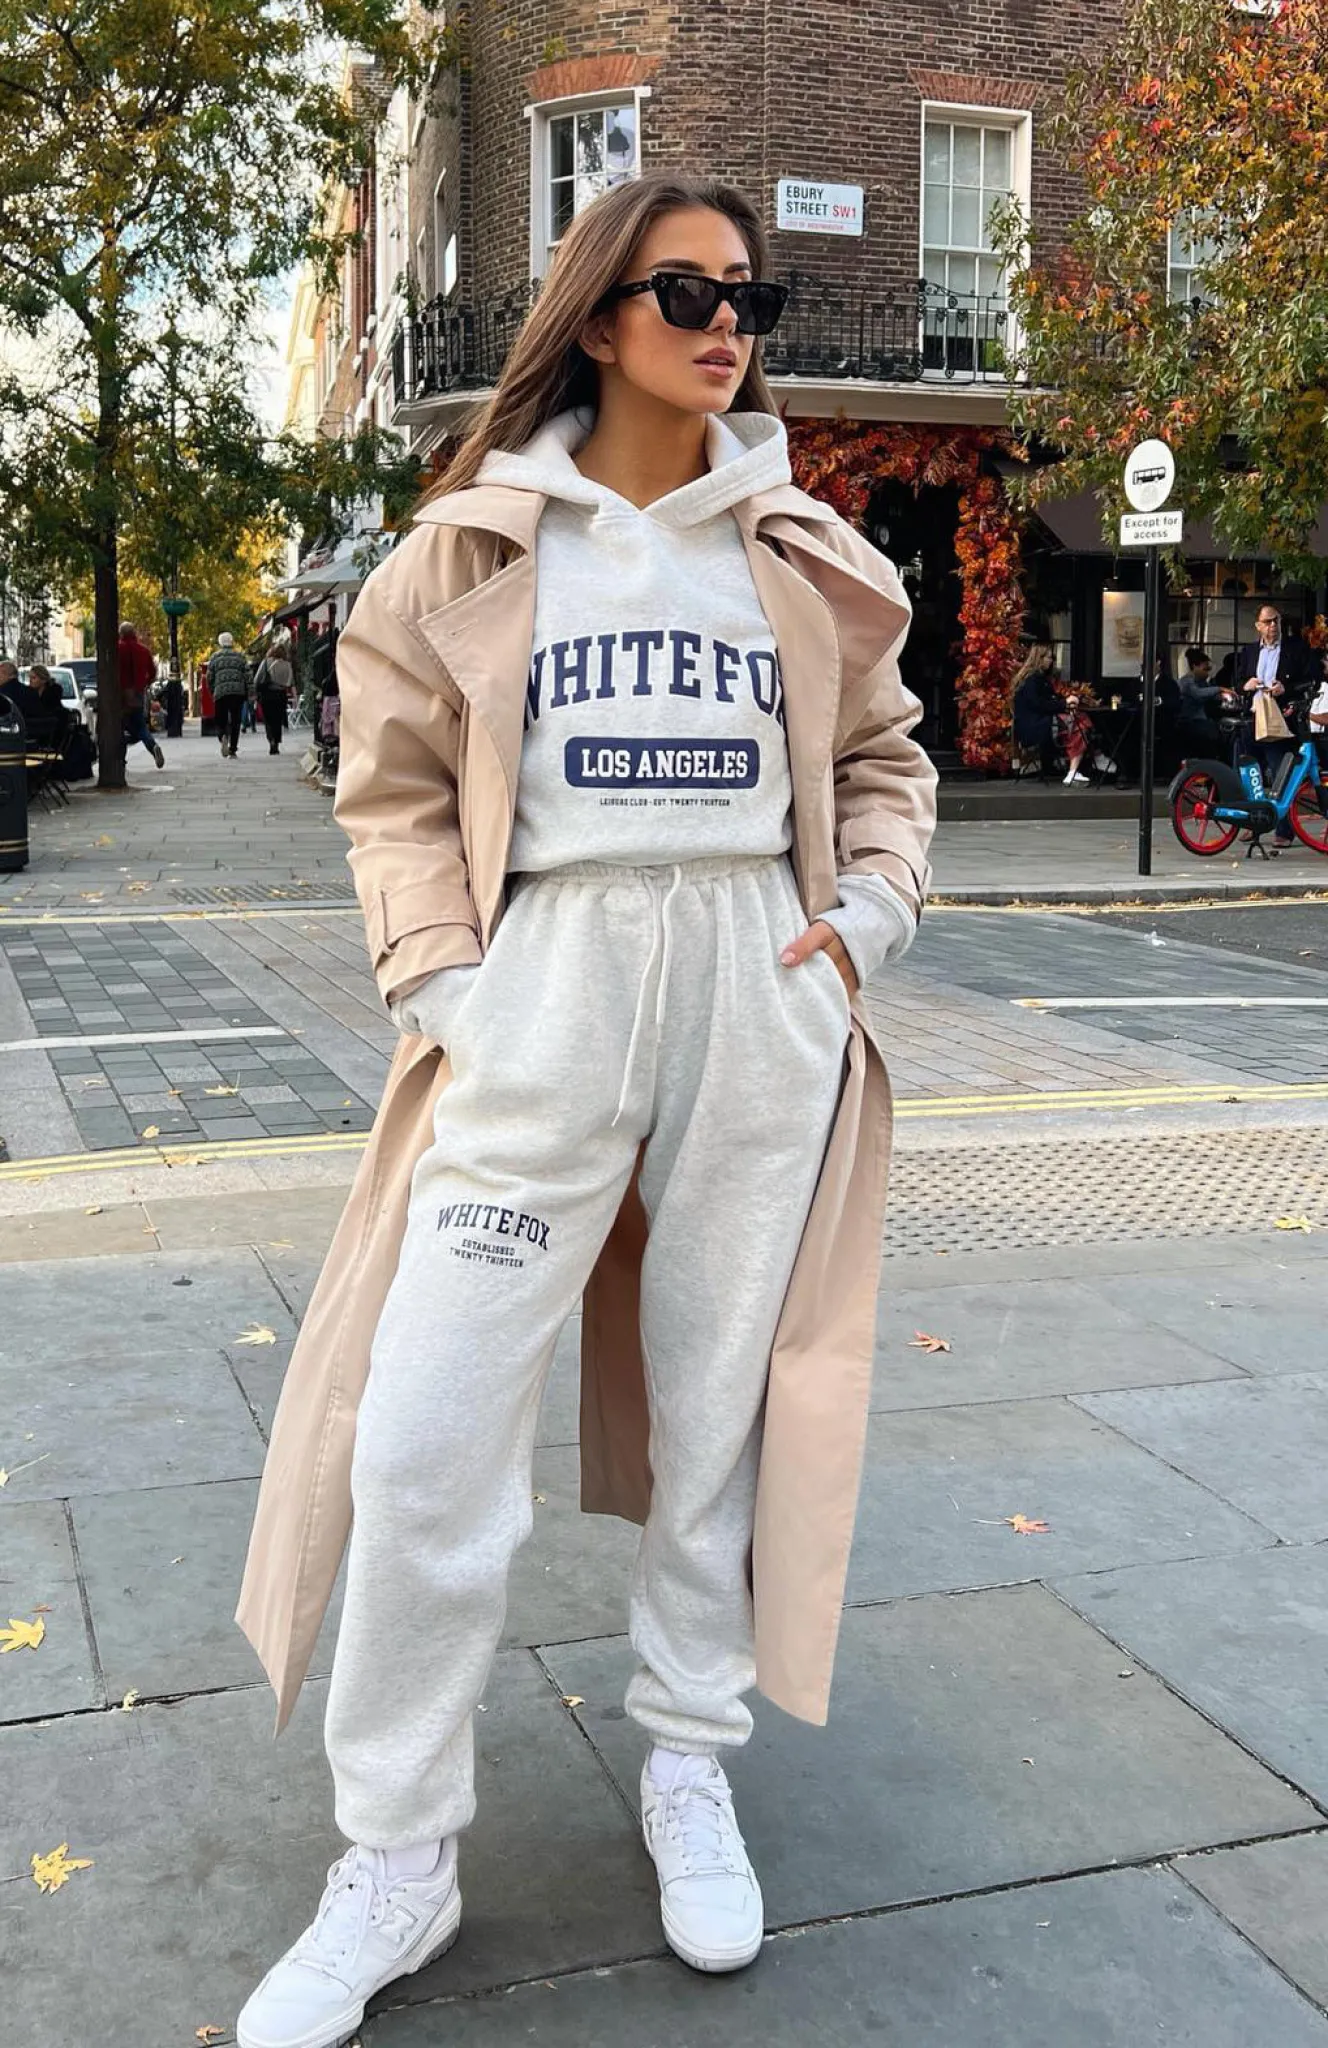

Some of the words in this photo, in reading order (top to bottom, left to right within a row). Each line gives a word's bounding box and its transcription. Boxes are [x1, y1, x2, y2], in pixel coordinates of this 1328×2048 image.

[786, 185, 823, 199] EBURY
[786, 201, 828, 216] STREET
[832, 205, 856, 219] SW1
[1125, 517, 1160, 528] Except
[1164, 516, 1178, 526] for
[1134, 529, 1168, 539] access
[712, 639, 783, 726] FO
[581, 748, 631, 777] LOS
[635, 749, 749, 779] ANGELES
[1250, 768, 1264, 799] dott
[437, 1203, 514, 1235] WHITE
[513, 1213, 551, 1251] FOX
[450, 1246, 484, 1262] TWENTY
[485, 1255, 524, 1268] THIRTEEN
[461, 1239, 516, 1256] ESTABLISHED
